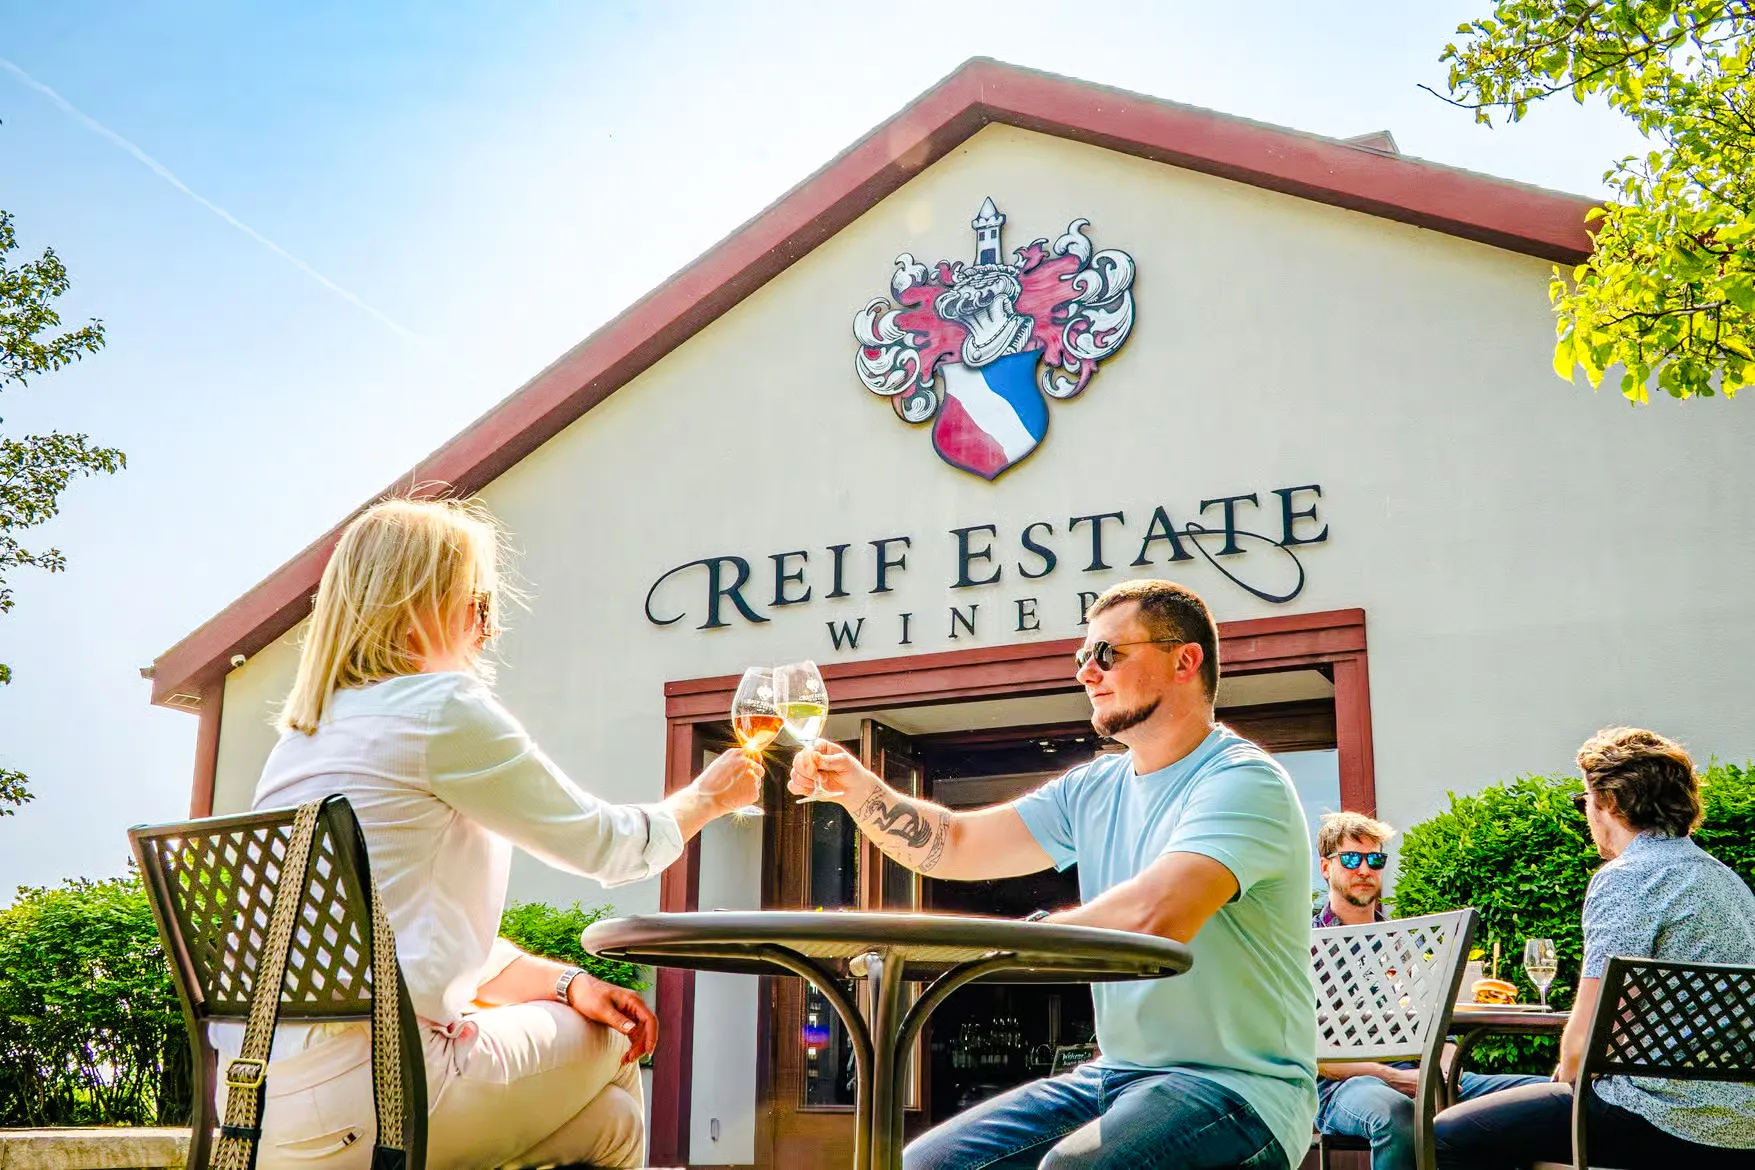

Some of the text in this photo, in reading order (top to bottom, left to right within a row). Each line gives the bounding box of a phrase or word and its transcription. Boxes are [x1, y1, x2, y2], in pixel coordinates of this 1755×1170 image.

[645, 484, 1329, 630] REIF ESTATE
[826, 592, 1099, 650] WINER
